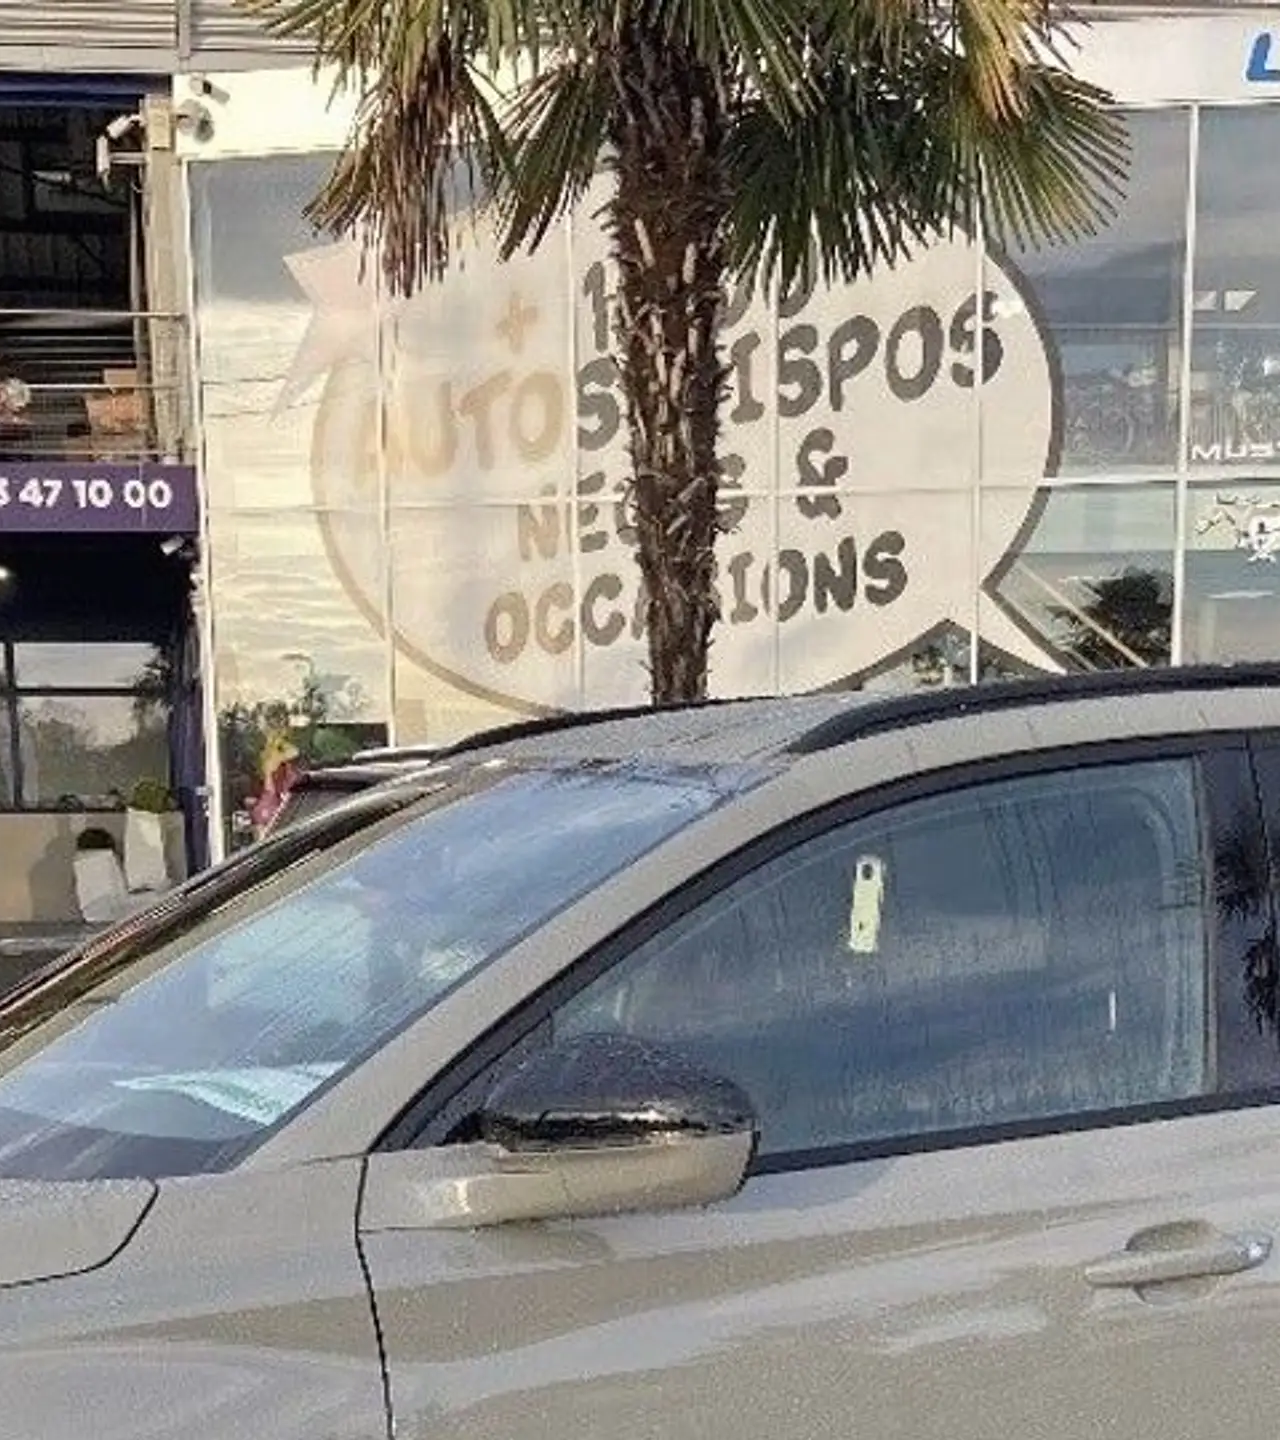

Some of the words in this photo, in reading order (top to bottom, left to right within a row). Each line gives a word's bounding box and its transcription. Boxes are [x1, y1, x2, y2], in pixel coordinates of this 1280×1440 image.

[19, 479, 63, 508] 47
[72, 479, 113, 508] 10
[123, 480, 172, 509] 00
[796, 424, 849, 522] &
